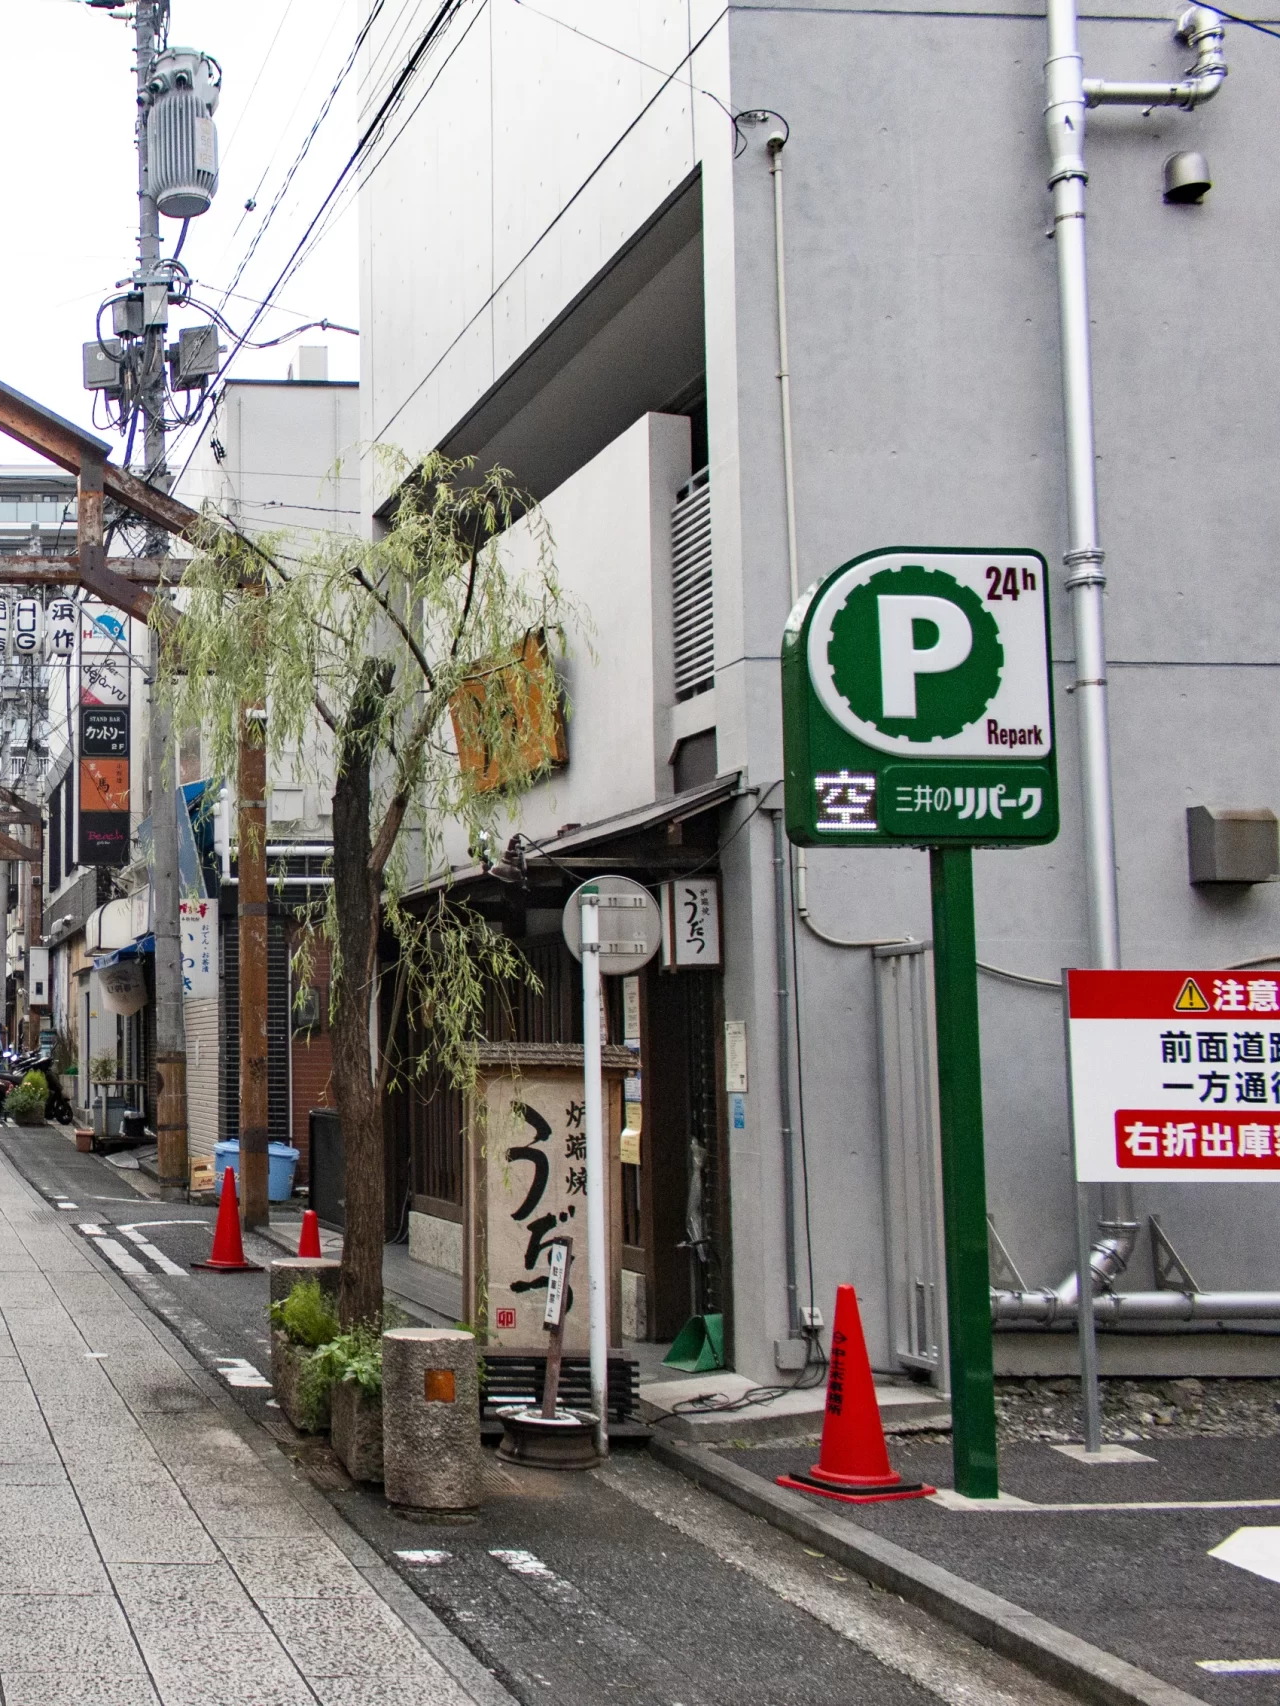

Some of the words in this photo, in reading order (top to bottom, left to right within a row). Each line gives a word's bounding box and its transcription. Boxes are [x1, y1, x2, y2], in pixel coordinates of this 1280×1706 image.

[985, 566, 1037, 601] 24h
[16, 602, 37, 650] HUG
[876, 594, 973, 719] P
[85, 726, 125, 740] カントリー
[987, 719, 1044, 749] Repark
[814, 770, 878, 831] 空
[896, 783, 1043, 820] 三井のリパーク
[684, 888, 705, 954] うだつ
[1213, 980, 1279, 1011] 注意
[1124, 1122, 1280, 1158] 右折出庫
[505, 1100, 575, 1313] うだつ
